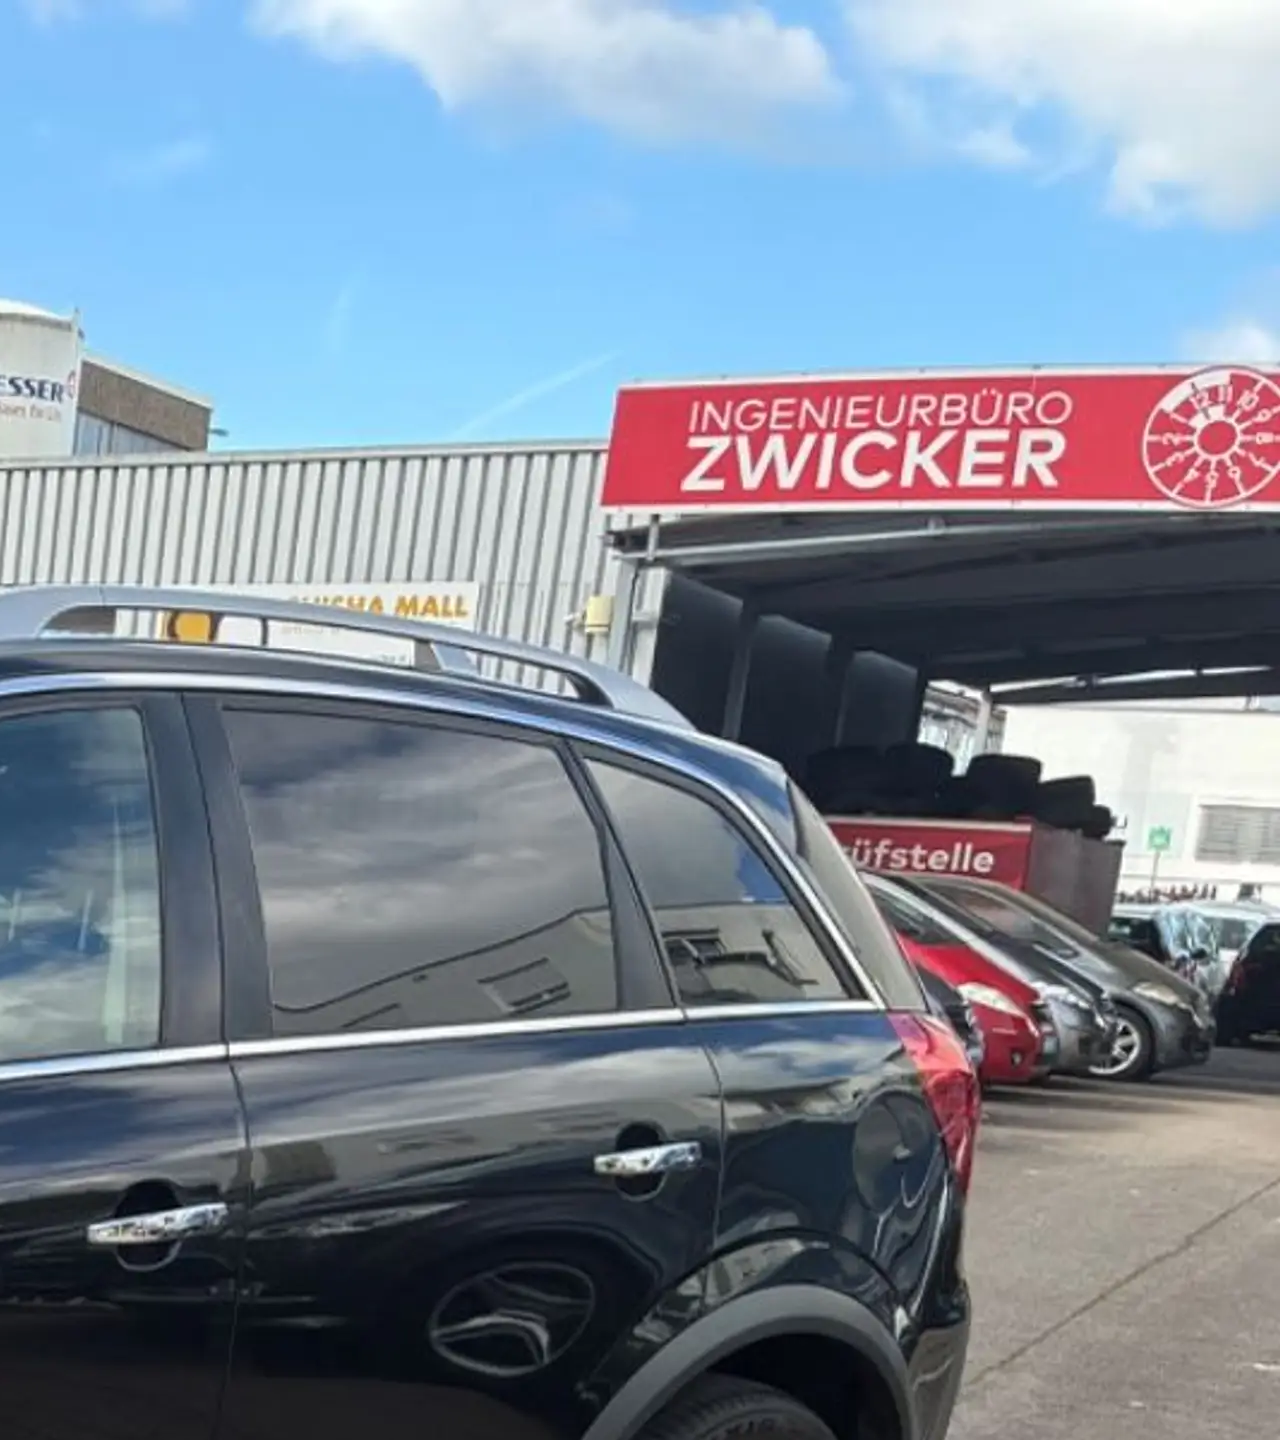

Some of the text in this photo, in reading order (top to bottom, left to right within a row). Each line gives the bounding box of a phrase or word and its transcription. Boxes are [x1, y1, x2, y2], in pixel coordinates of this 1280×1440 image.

[689, 388, 1072, 433] INGENIEURBÜRO
[681, 428, 1067, 491] ZWICKER
[394, 593, 469, 618] MALL
